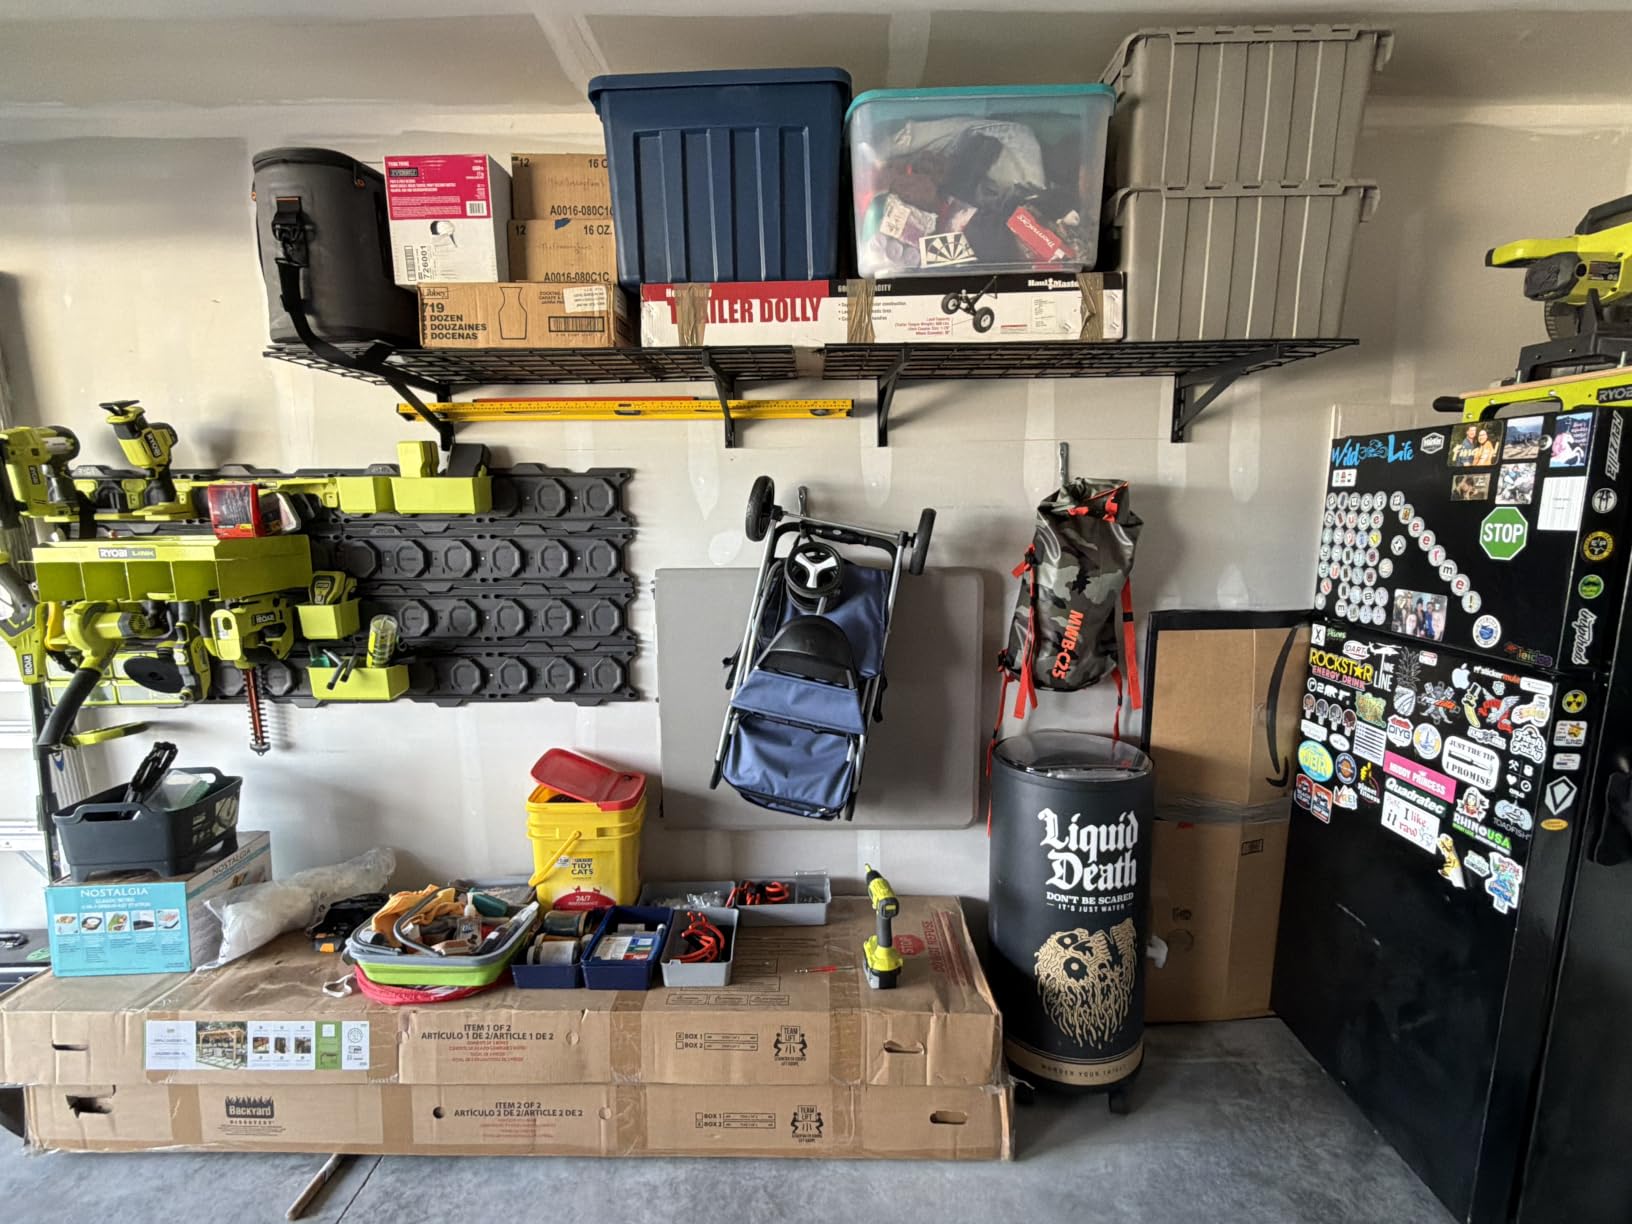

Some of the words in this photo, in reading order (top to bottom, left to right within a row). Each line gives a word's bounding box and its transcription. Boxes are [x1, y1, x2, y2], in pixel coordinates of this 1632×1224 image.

[519, 158, 530, 168] 12
[588, 158, 600, 168] 16
[515, 225, 526, 235] 12
[583, 224, 594, 235] 16
[596, 224, 612, 235] OZ.
[1028, 279, 1048, 287] Haul
[1054, 279, 1080, 288] Maste
[422, 302, 445, 313] 719
[667, 298, 753, 325] TAILER
[759, 297, 822, 323] DOLLY
[430, 314, 463, 322] DOZEN
[431, 323, 487, 331] DOUZAINES
[431, 332, 478, 340] DOCENAS
[1332, 438, 1361, 467] Wild
[1387, 433, 1415, 463] Life
[1483, 523, 1524, 544] STOP
[100, 549, 128, 558] RYOBI
[1051, 609, 1085, 680] MWB-C25
[23, 654, 33, 675] RYOBI
[1312, 666, 1340, 683] ENERGY
[1342, 674, 1366, 692] DRINK
[1373, 671, 1394, 692] LINE
[1449, 739, 1466, 751] JUST
[1467, 746, 1481, 757] THE
[1483, 752, 1496, 761] TIP
[1451, 763, 1492, 788] PROMISE
[1385, 777, 1446, 815] Quadratec
[1037, 807, 1139, 864] Liquid
[1453, 814, 1488, 836] RHINO
[1487, 828, 1512, 849] USA
[1045, 848, 1137, 892] Death
[80, 887, 149, 897] NOSTALGIA
[1046, 891, 1080, 904] DON'T
[1081, 896, 1097, 905] BE
[1098, 891, 1134, 905] SCARED
[1058, 903, 1076, 911] IT'S
[1101, 903, 1125, 912] WATER
[464, 1023, 485, 1032] ITEM
[784, 1027, 798, 1035] TEAM
[421, 1031, 464, 1040] ARTÍCULO
[229, 1104, 271, 1116] Backyard
[454, 1108, 495, 1117] ARTÍCULO
[503, 1109, 514, 1117] DE
